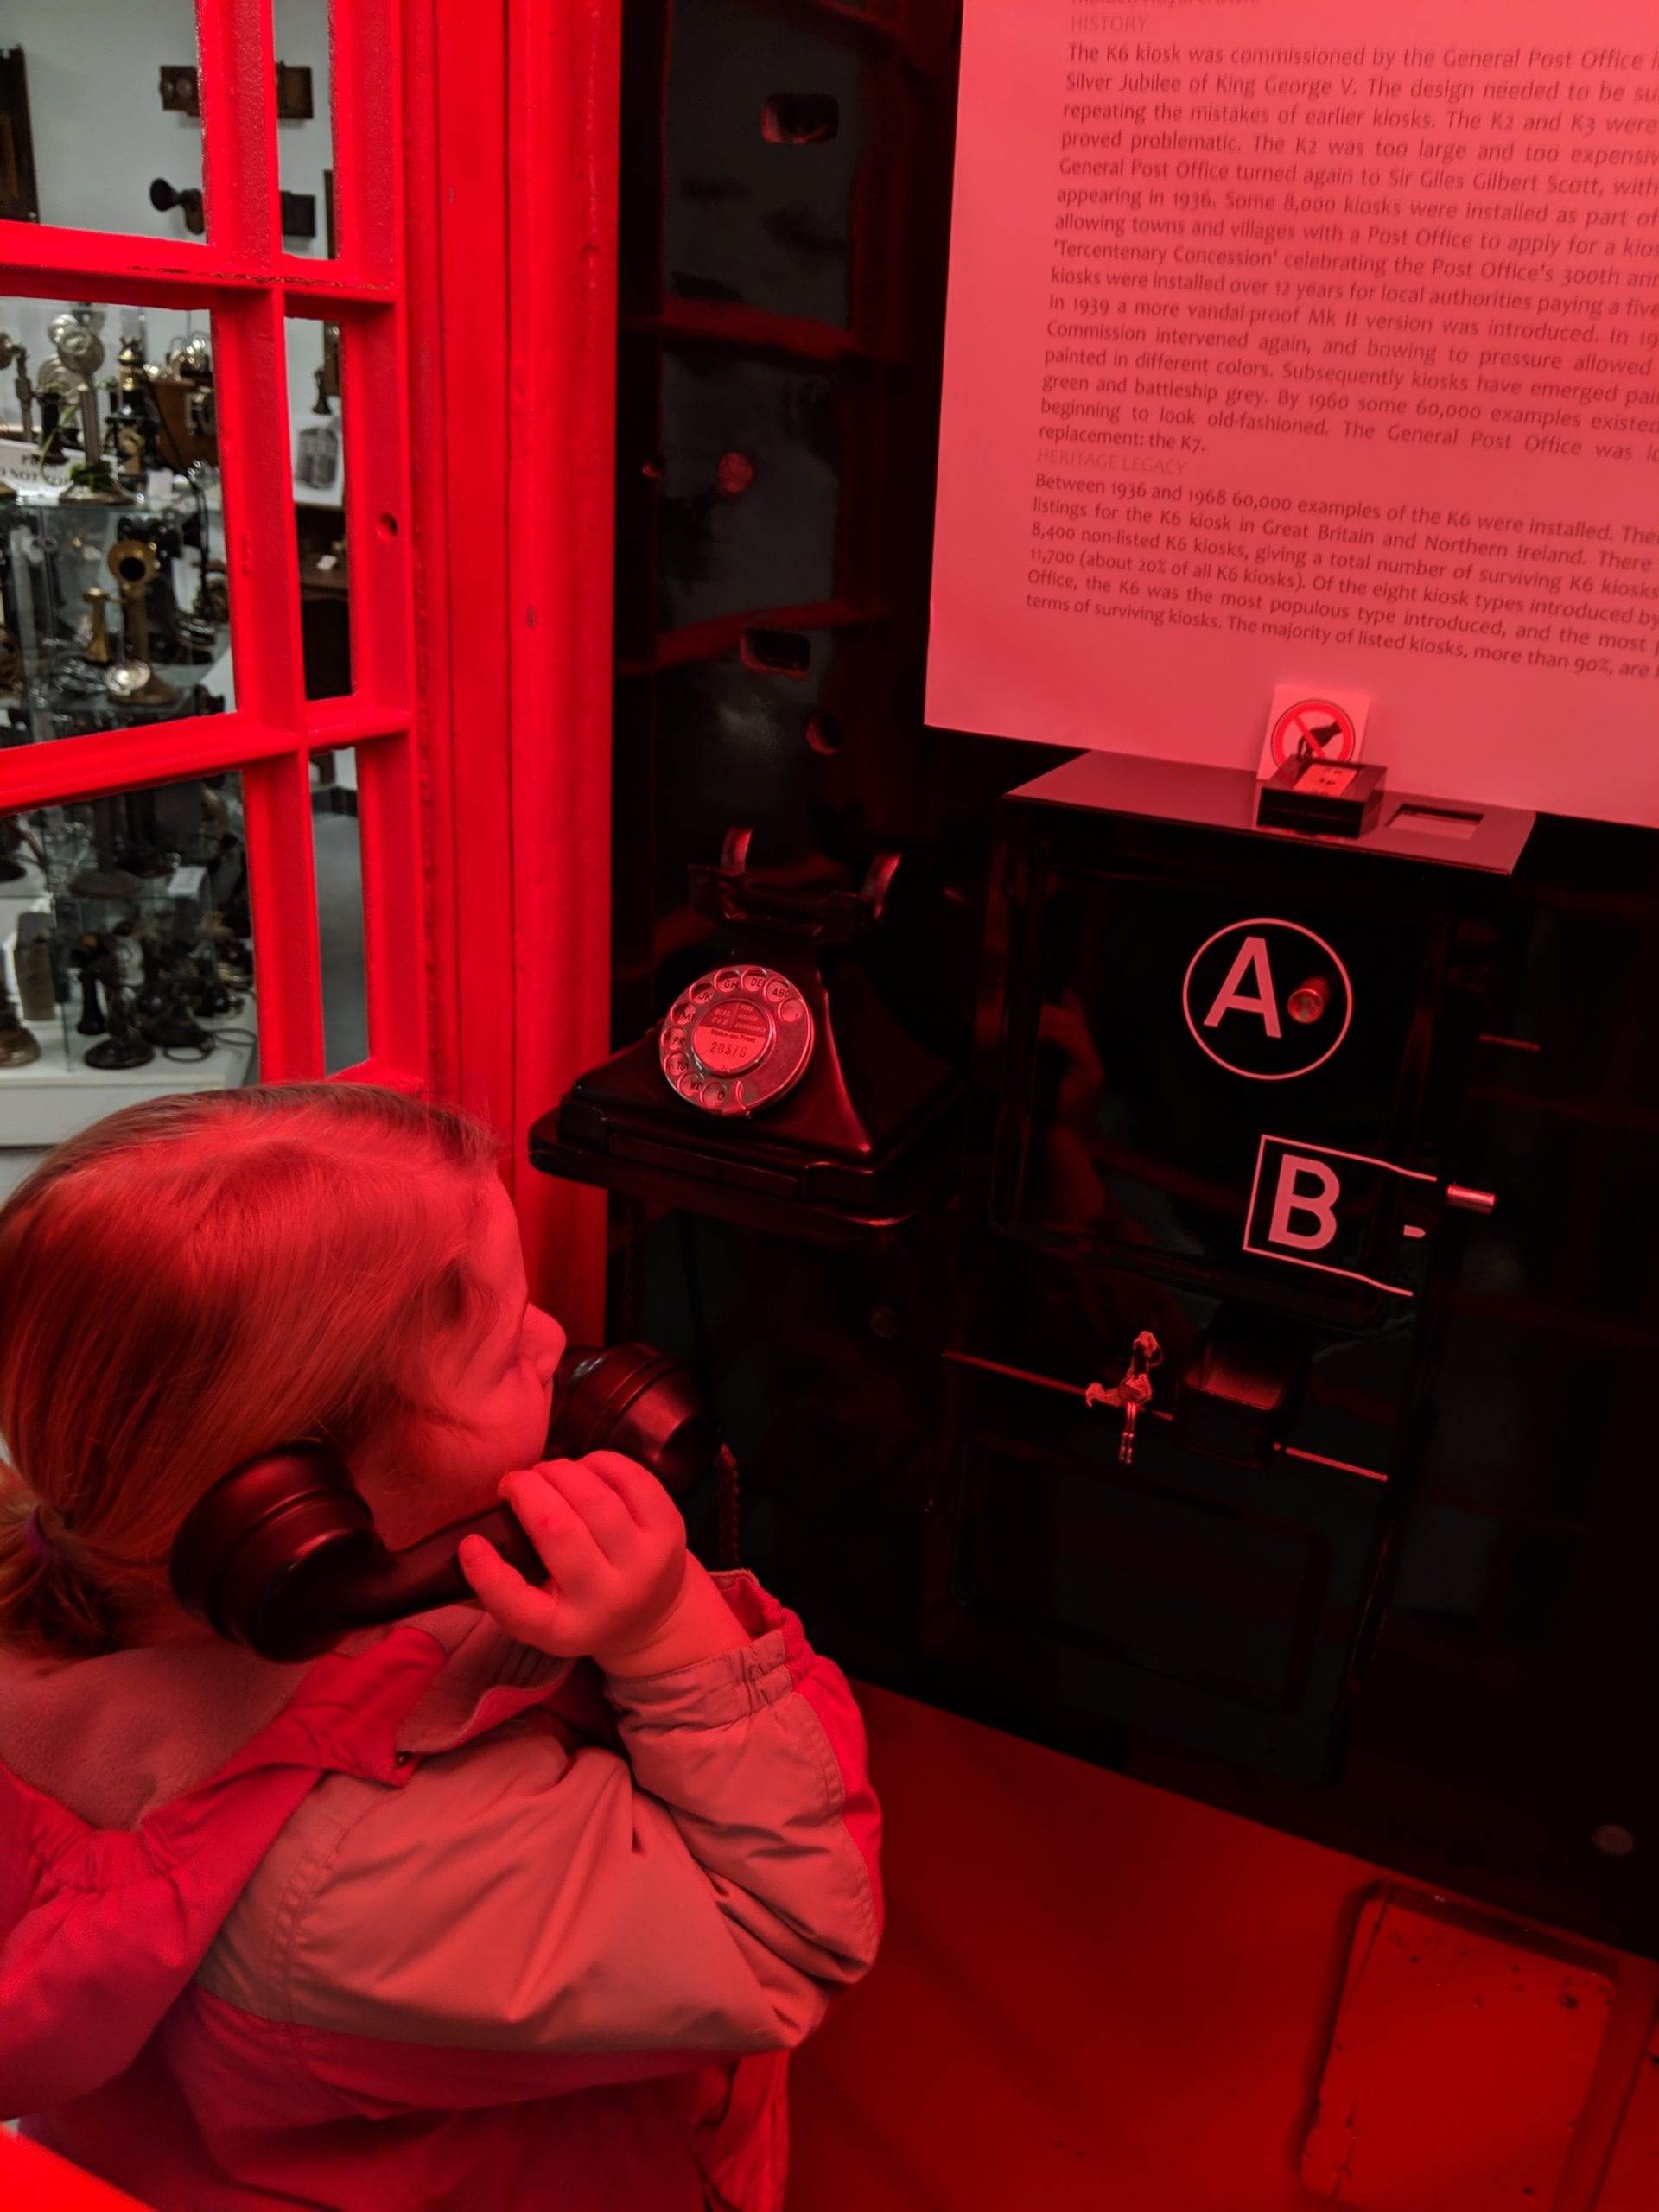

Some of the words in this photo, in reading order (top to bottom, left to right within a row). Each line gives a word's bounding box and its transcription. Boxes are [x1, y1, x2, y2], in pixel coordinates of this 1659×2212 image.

[1071, 16, 1147, 32] HISTORY
[1064, 102, 1146, 125] repeating
[1154, 102, 1182, 122] the
[1191, 104, 1268, 124] mistakes
[1278, 105, 1297, 124] of
[1306, 106, 1364, 126] earlier
[1373, 106, 1435, 129] kiosks.
[1447, 109, 1481, 130] The
[1491, 111, 1514, 131] K2
[1523, 111, 1561, 132] and
[1571, 113, 1595, 137] K3
[1059, 156, 1124, 176] General
[1131, 158, 1168, 179] Post
[1176, 160, 1229, 181] Office
[1236, 163, 1297, 182] turned
[1303, 167, 1353, 189] again
[1362, 168, 1380, 187] to
[1389, 168, 1413, 188] Sir
[1421, 169, 1464, 189] Giles
[1473, 170, 1537, 192] Gilbert
[1548, 175, 1603, 198] Scott,
[1054, 238, 1167, 265] 'Tercentenary
[1173, 245, 1277, 267] Concession'
[1284, 251, 1387, 278] celebrating
[1395, 256, 1424, 276] the
[1433, 257, 1472, 278] Post
[1481, 261, 1554, 283] Office's
[1562, 266, 1619, 287] 300th
[1050, 294, 1065, 311] In
[1074, 297, 1109, 316] 1939
[1117, 301, 1127, 315] a
[1135, 301, 1179, 318] more
[1188, 302, 1300, 327] vandal-proof
[1308, 308, 1335, 327] Mk
[1345, 310, 1357, 327] II
[1367, 315, 1433, 333] version
[1442, 320, 1478, 336] was
[1489, 319, 1598, 343] introduced.
[1610, 327, 1629, 346] In
[1041, 397, 1120, 425] beginning
[1132, 405, 1149, 422] to
[1160, 406, 1195, 425] look
[1207, 410, 1329, 436] old-fashioned.
[1344, 420, 1376, 441] The
[1388, 423, 1459, 446] General
[1471, 430, 1511, 451] Post
[1525, 435, 1582, 456] Office
[1595, 444, 1632, 461] was
[1042, 374, 1089, 393] green
[1096, 377, 1127, 394] and
[1135, 378, 1217, 404] battleship
[1225, 387, 1268, 408] grey.
[1278, 388, 1299, 411] By
[1309, 392, 1349, 412] 1960
[1358, 397, 1407, 415] some
[1416, 398, 1481, 420] 60,000
[1491, 408, 1580, 429] examples
[1038, 448, 1116, 470] HERITAGE
[1122, 455, 1186, 476] LEGACY
[1039, 424, 1143, 447] replacement:
[1149, 431, 1175, 450] the
[1181, 435, 1205, 454] K7.
[1033, 496, 1087, 521] listings
[1096, 502, 1118, 520] for
[1127, 505, 1152, 524] the
[1160, 509, 1181, 527] K6
[1190, 511, 1230, 531] kiosk
[1239, 516, 1255, 534] in
[1262, 519, 1308, 539] Great
[1318, 524, 1374, 545] Britain
[1382, 532, 1416, 550] and
[1425, 534, 1508, 558] Northern
[1517, 543, 1586, 566] Ireland.
[1599, 550, 1652, 573] There
[1036, 472, 1105, 494] Between
[1112, 481, 1147, 500] 1936
[1152, 485, 1182, 502] and
[1189, 488, 1226, 506] 1968
[1232, 491, 1292, 512] 60,000
[1298, 499, 1381, 521] examples
[1387, 504, 1407, 522] of
[1412, 506, 1441, 525] the
[1447, 510, 1471, 528] K6
[1478, 516, 1524, 533] were
[1529, 517, 1612, 542] installed.
[1031, 547, 1075, 565] 11,700
[1080, 550, 1132, 571] (about
[1139, 559, 1166, 575] 20%
[1171, 560, 1188, 576] of
[1193, 563, 1211, 579] all
[1217, 565, 1237, 582] K6
[1244, 567, 1305, 593] kiosks).
[1313, 575, 1334, 592] Of
[1339, 578, 1367, 596] the
[1373, 582, 1416, 604] eight
[1423, 586, 1468, 607] kiosk
[1476, 593, 1523, 613] types
[1530, 598, 1633, 624] introduced
[1032, 520, 1075, 541] 8,400
[1082, 529, 1160, 550] non-listed
[1166, 535, 1187, 552] K6
[1194, 537, 1248, 561] kiosks,
[1255, 545, 1306, 569] giving
[1313, 553, 1322, 566] a
[1330, 552, 1370, 570] total
[1377, 559, 1446, 578] number
[1453, 563, 1473, 580] of
[1479, 569, 1562, 594] surviving
[1570, 575, 1593, 594] K6
[1027, 569, 1077, 592] Office,
[1086, 575, 1111, 594] the
[1120, 580, 1140, 596] K6
[1147, 586, 1179, 601] was
[1187, 586, 1212, 604] the
[1221, 593, 1262, 610] most
[1270, 599, 1349, 620] populous
[1358, 606, 1395, 626] type
[1404, 610, 1506, 639] introduced,
[1516, 624, 1551, 641] and
[1560, 627, 1590, 646] the
[1599, 634, 1646, 652] most
[1027, 594, 1069, 613] terms
[1074, 598, 1090, 613] of
[1095, 603, 1164, 628] surviving
[1168, 608, 1221, 630] kiosks.
[1228, 614, 1257, 634] The
[1262, 622, 1331, 645] majority
[1335, 628, 1354, 645] of
[1358, 629, 1406, 651] listed
[1409, 635, 1468, 660] kiosks,
[1474, 646, 1522, 664] more
[1528, 649, 1568, 669] than
[1574, 657, 1613, 677] 90%,
[1618, 663, 1649, 679] are
[1204, 936, 1281, 1038] A
[710, 1041, 747, 1058] 20376
[1268, 1154, 1340, 1250] B
